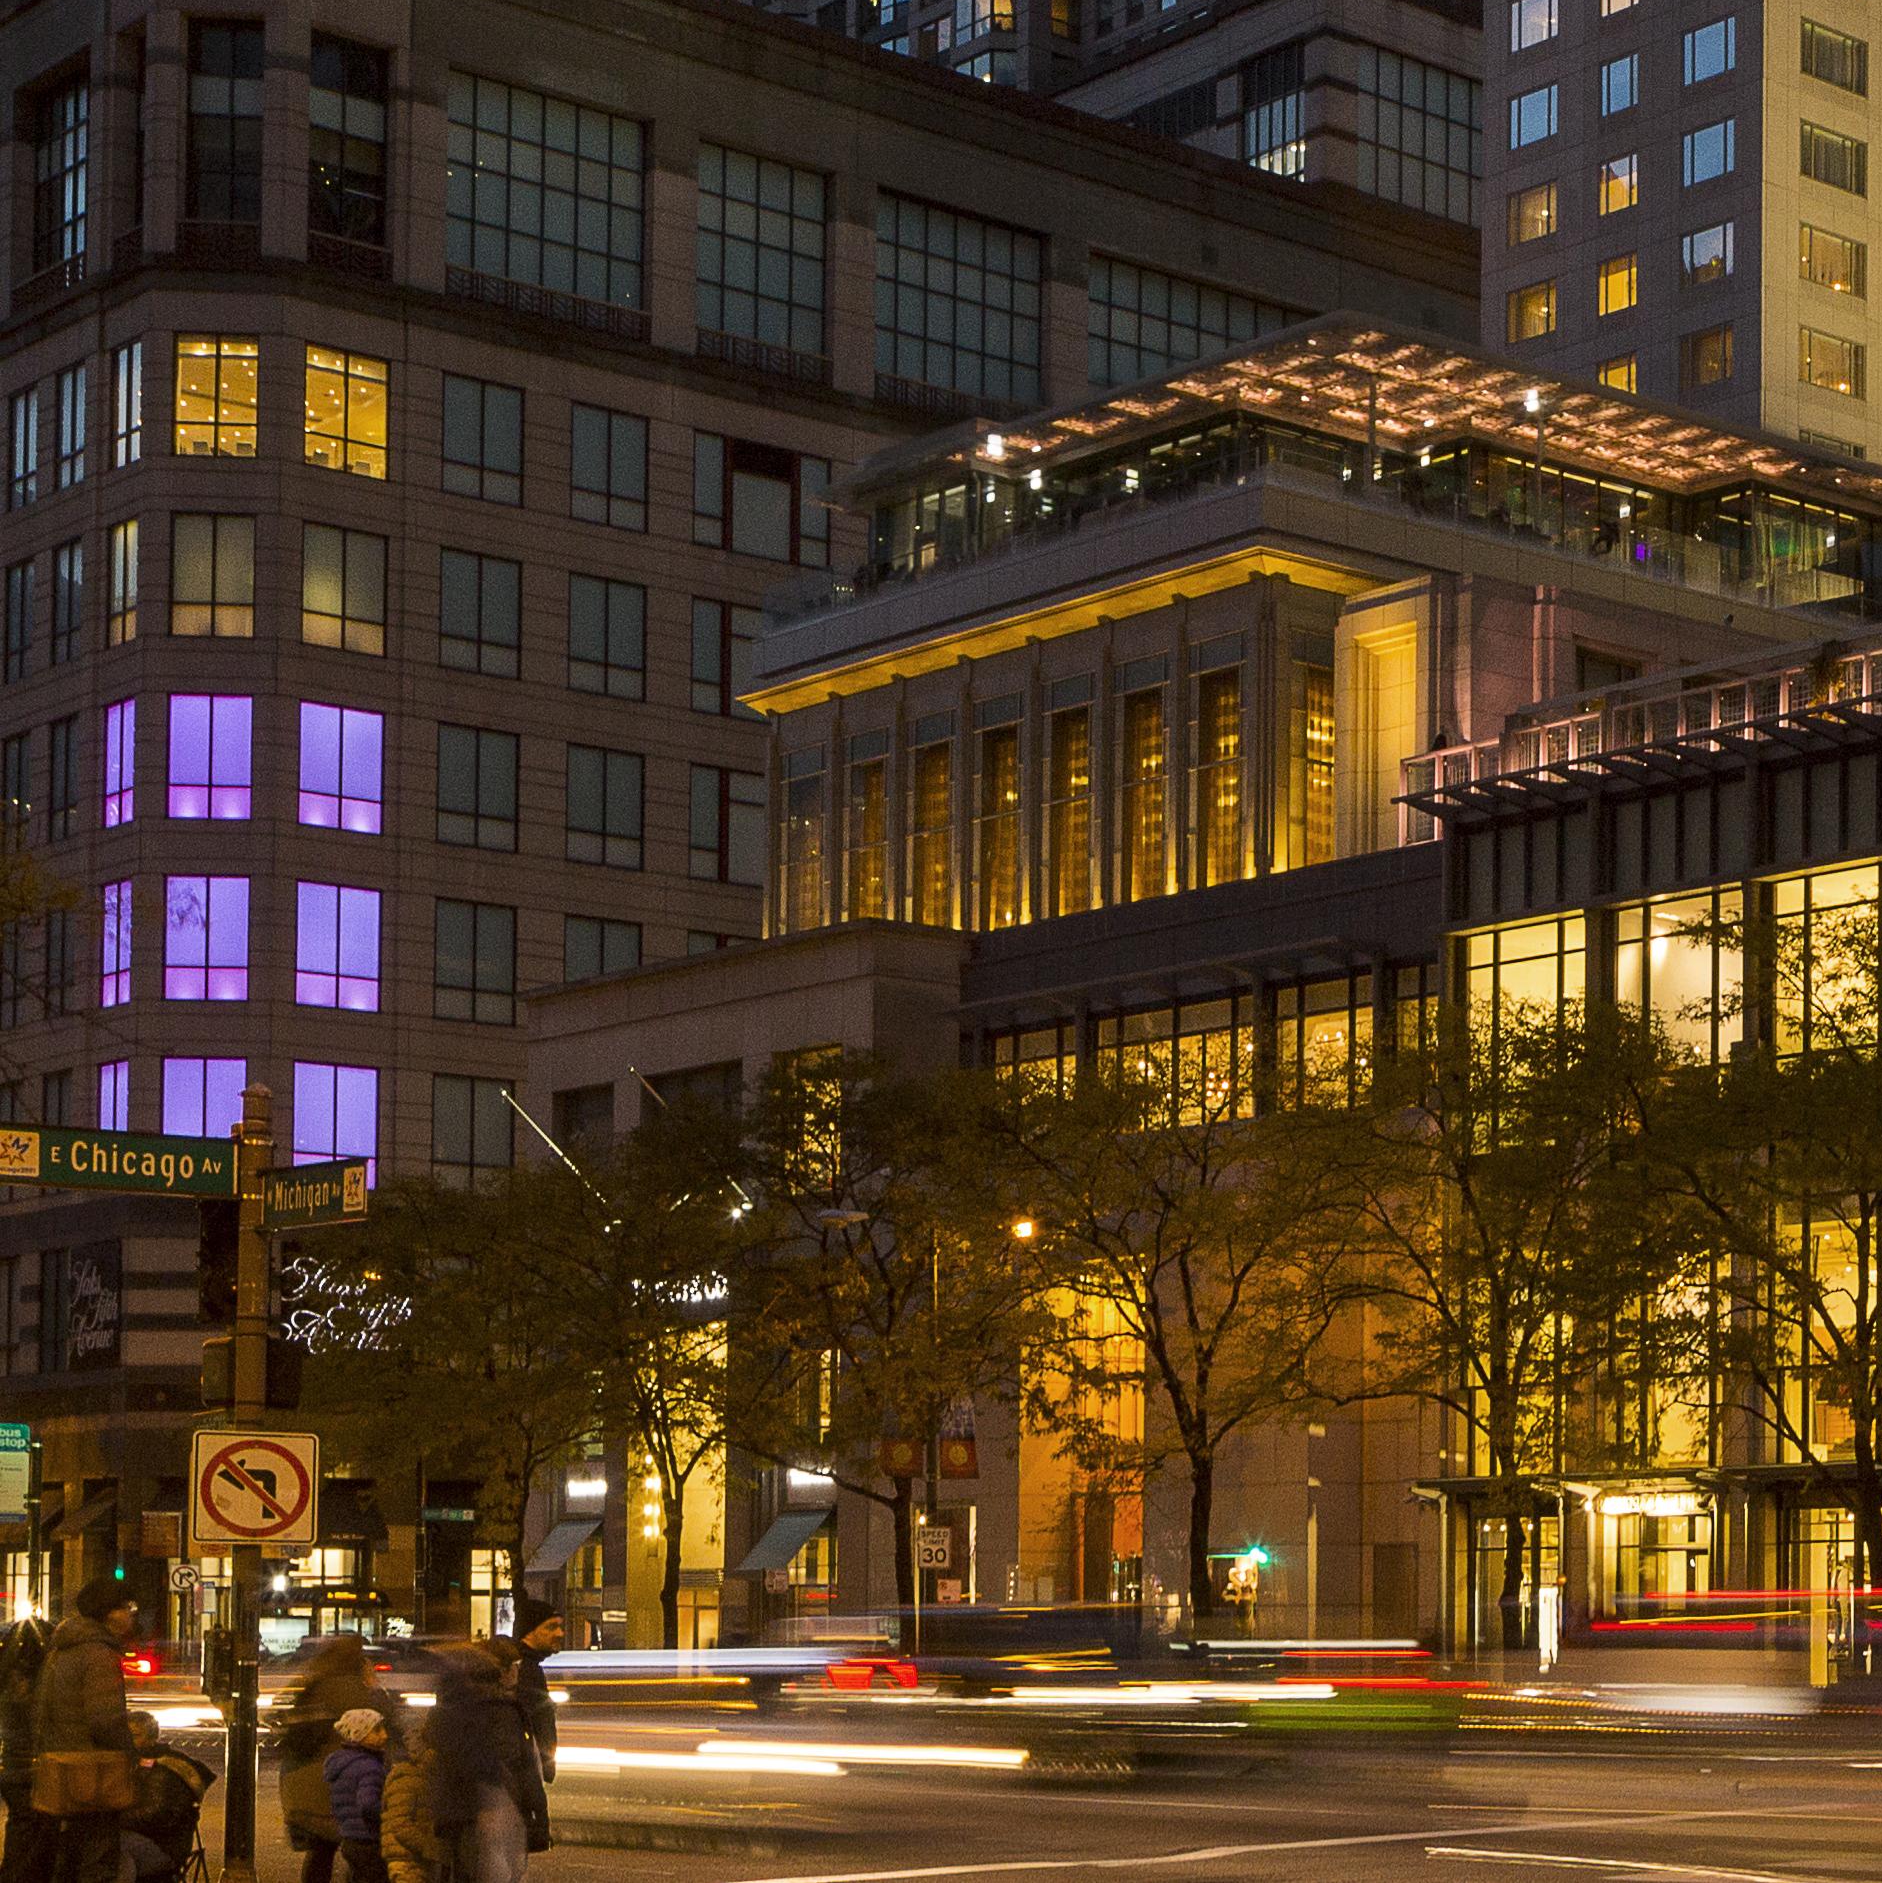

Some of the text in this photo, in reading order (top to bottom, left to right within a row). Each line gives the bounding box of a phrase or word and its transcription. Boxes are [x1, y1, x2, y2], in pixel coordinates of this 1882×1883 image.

[50, 1140, 223, 1188] E Chicago Av
[274, 1179, 330, 1217] Michigan
[920, 1530, 949, 1539] SPEED
[922, 1547, 947, 1564] 30
